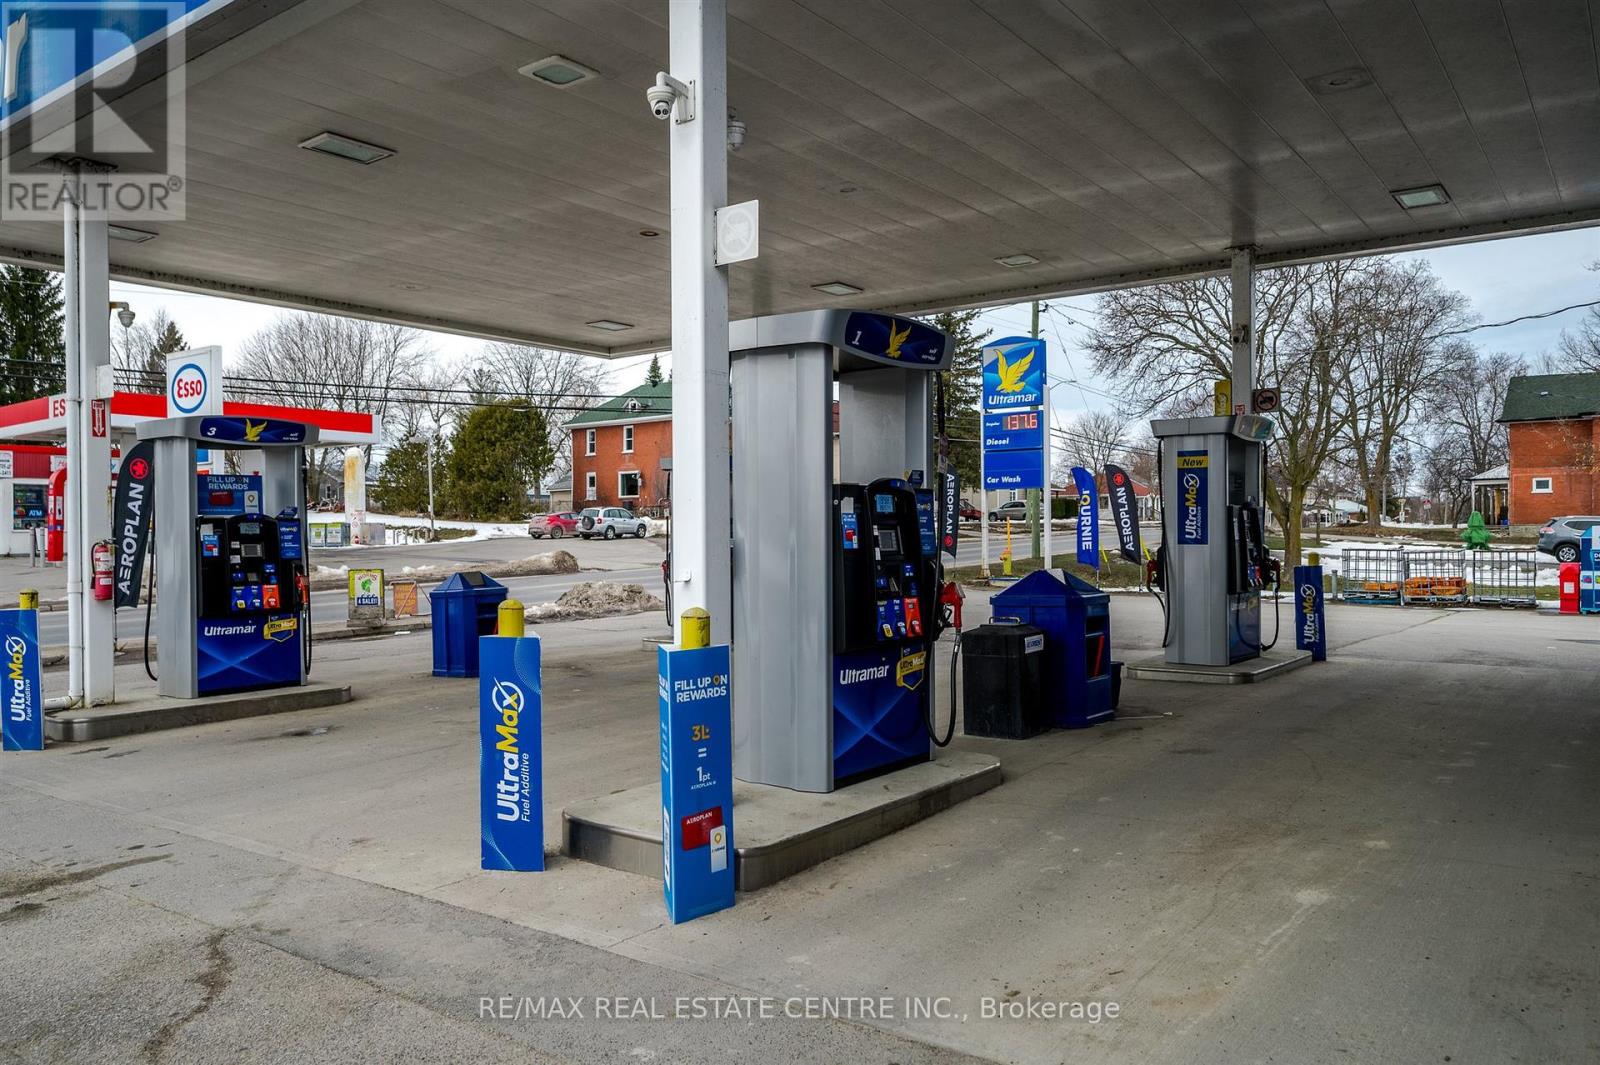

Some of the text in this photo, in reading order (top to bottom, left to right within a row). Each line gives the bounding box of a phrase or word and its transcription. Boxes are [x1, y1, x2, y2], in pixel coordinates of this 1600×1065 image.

[851, 330, 862, 345] 1
[176, 378, 203, 398] Esso
[988, 393, 1038, 405] Ultramar
[1007, 412, 1038, 430] 137.6
[207, 427, 217, 436] 3
[985, 436, 1010, 446] Diesel
[1182, 458, 1205, 467] New
[986, 475, 1022, 484] Car Wash
[946, 473, 955, 534] AEROPLAN
[1184, 472, 1200, 539] UltraMax
[28, 509, 43, 517] ATM
[1080, 488, 1093, 551] JOURNIE
[1116, 486, 1135, 551] AEROPLAN
[117, 482, 145, 596] AEROPLAN
[1300, 583, 1316, 644] UltraMax
[204, 624, 257, 636] Ultramar
[6, 635, 26, 722] UltraMax
[839, 664, 890, 685] Ultramar
[674, 679, 697, 692] FILL
[697, 677, 712, 688] UP
[676, 686, 727, 703] REWARDS
[492, 676, 525, 822] UltraMax
[696, 766, 711, 782] 1pt
[521, 752, 531, 822] Fuel Additive
[690, 781, 713, 790] AEROPLAN
[686, 811, 713, 825] AEROPLAN
